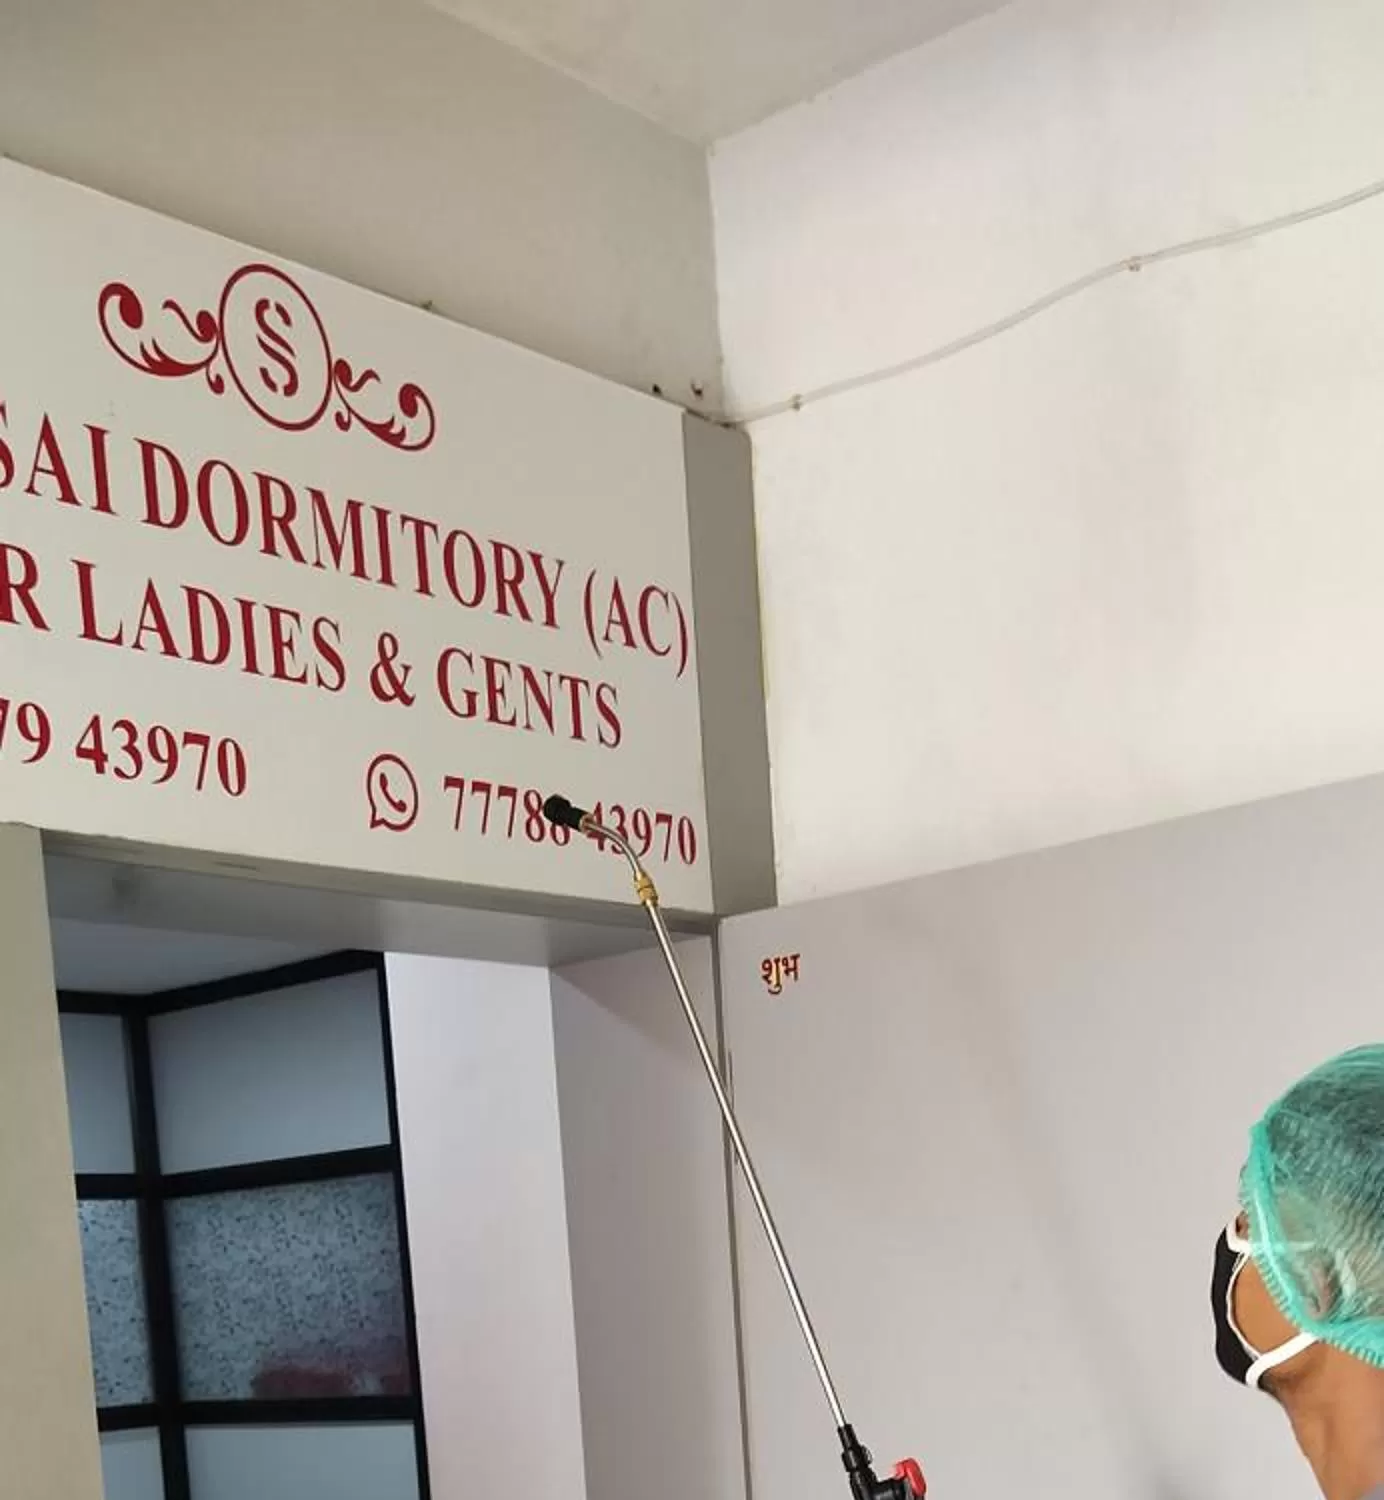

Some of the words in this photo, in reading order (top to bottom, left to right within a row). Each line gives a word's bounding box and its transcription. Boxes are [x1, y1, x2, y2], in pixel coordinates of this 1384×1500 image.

[135, 437, 565, 632] DORMITORY
[583, 569, 690, 679] (AC)
[0, 541, 51, 633] R
[70, 557, 347, 693] LADIES
[369, 631, 417, 707] &
[436, 645, 622, 749] GENTS
[74, 713, 248, 798] 43970
[585, 800, 698, 866] 43970
[761, 953, 801, 996] शुभ
